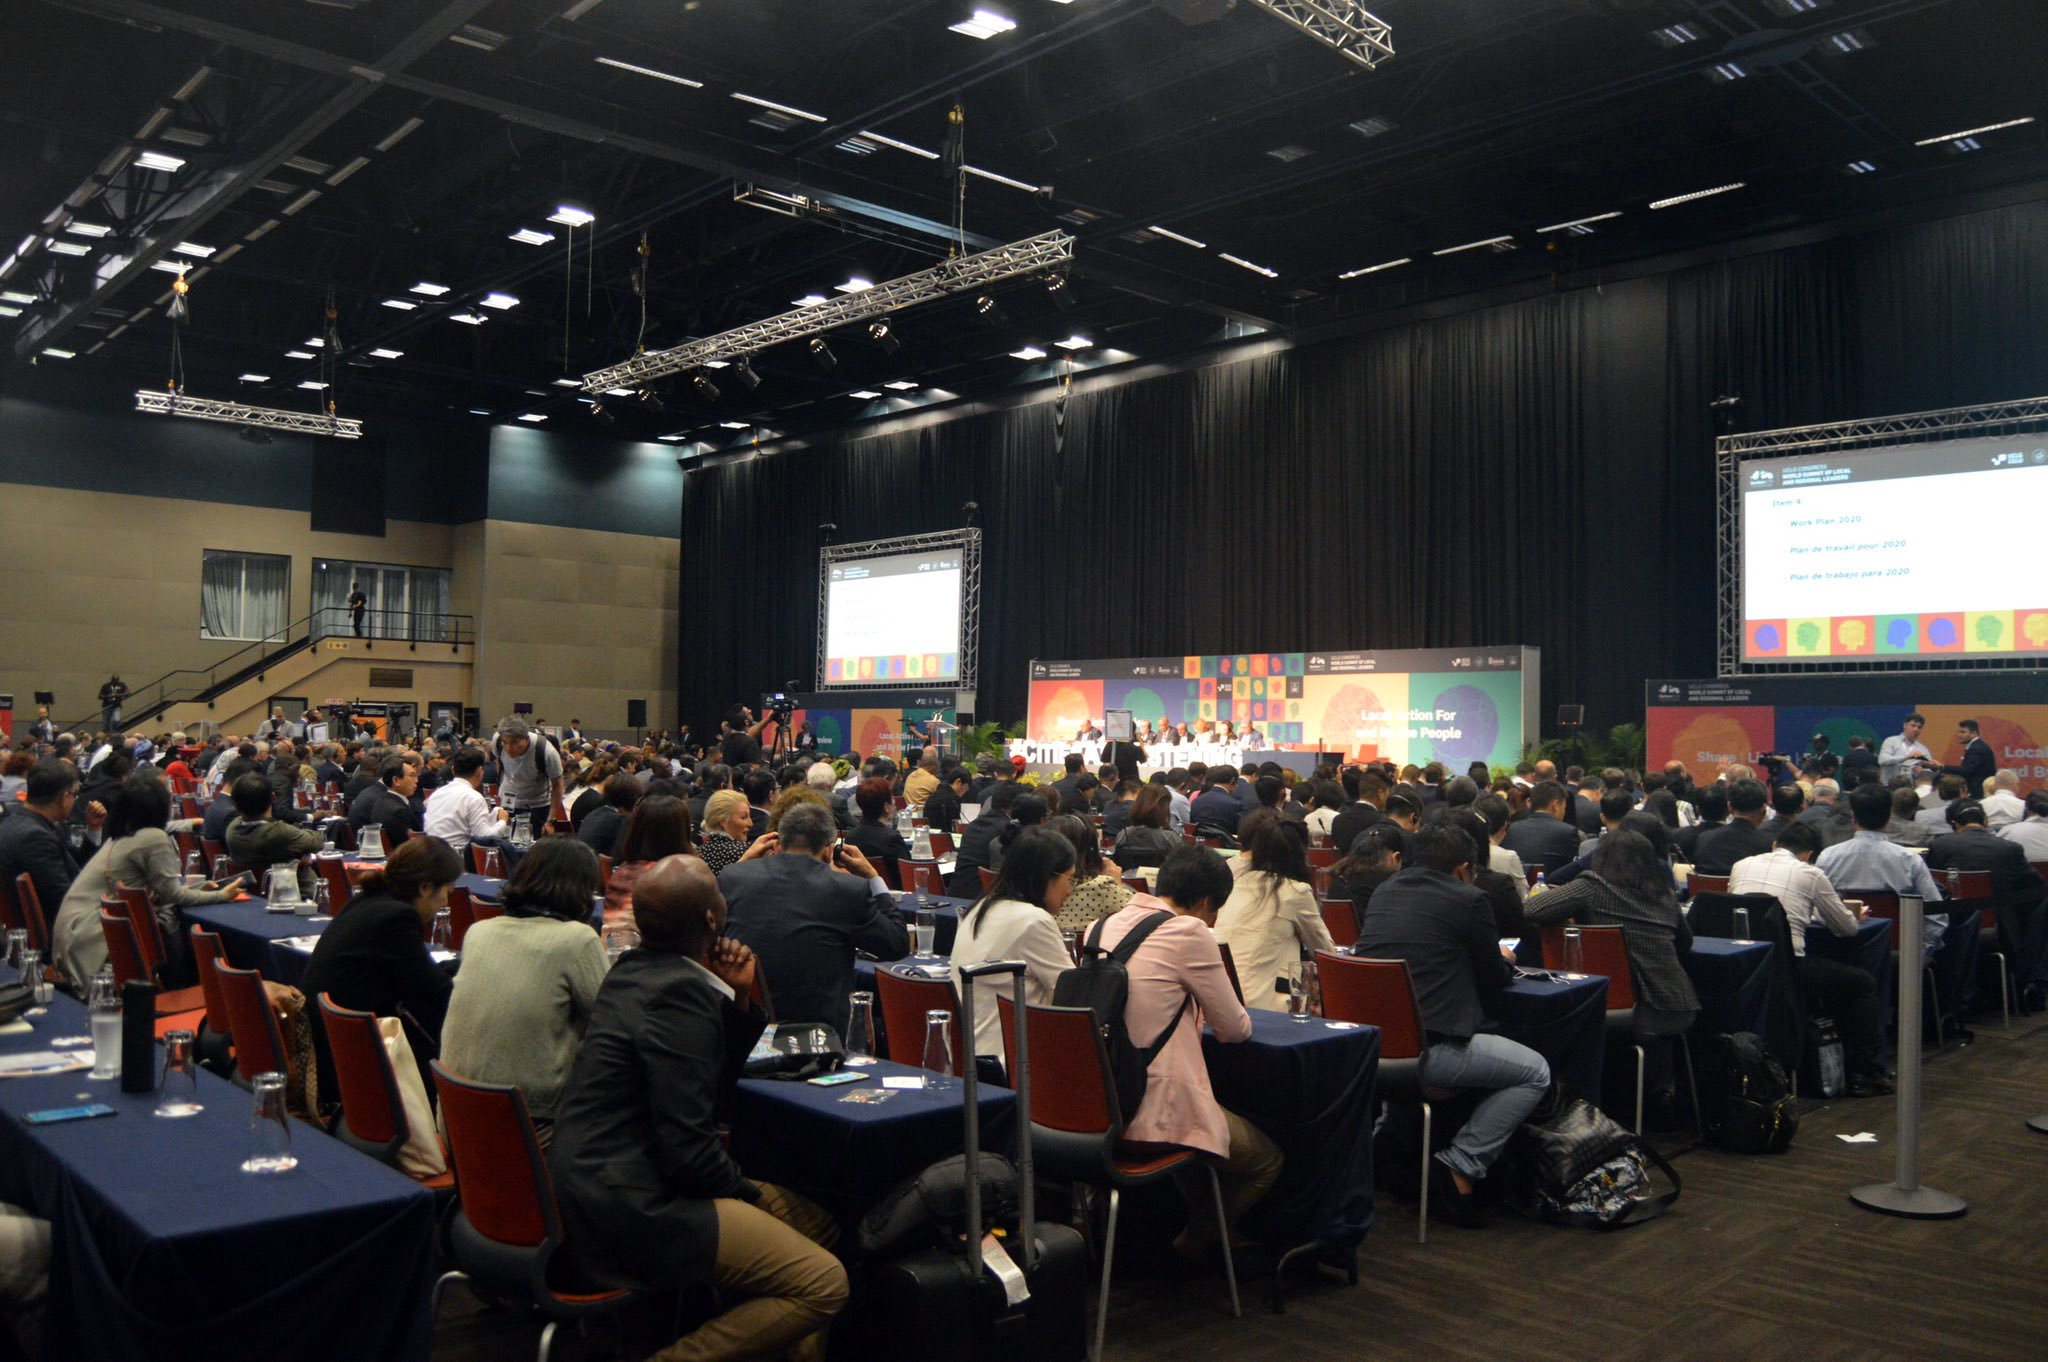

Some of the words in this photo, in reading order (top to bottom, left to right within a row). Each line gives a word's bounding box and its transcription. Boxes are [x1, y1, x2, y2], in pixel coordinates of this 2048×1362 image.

[1790, 519, 1812, 527] Work
[1839, 515, 1862, 524] 2020
[1790, 546, 1809, 554] Plan
[1812, 545, 1823, 553] de
[1826, 543, 1855, 551] travail
[1857, 542, 1879, 551] pour
[1882, 539, 1907, 549] 2020
[1790, 573, 1809, 581] Plan
[1812, 572, 1823, 580] de
[1826, 570, 1859, 580] trabajo
[1861, 569, 1883, 578] para
[1886, 567, 1910, 576] 2020
[1361, 709, 1393, 721] Local
[1435, 709, 1457, 721] For
[1420, 726, 1462, 742] People
